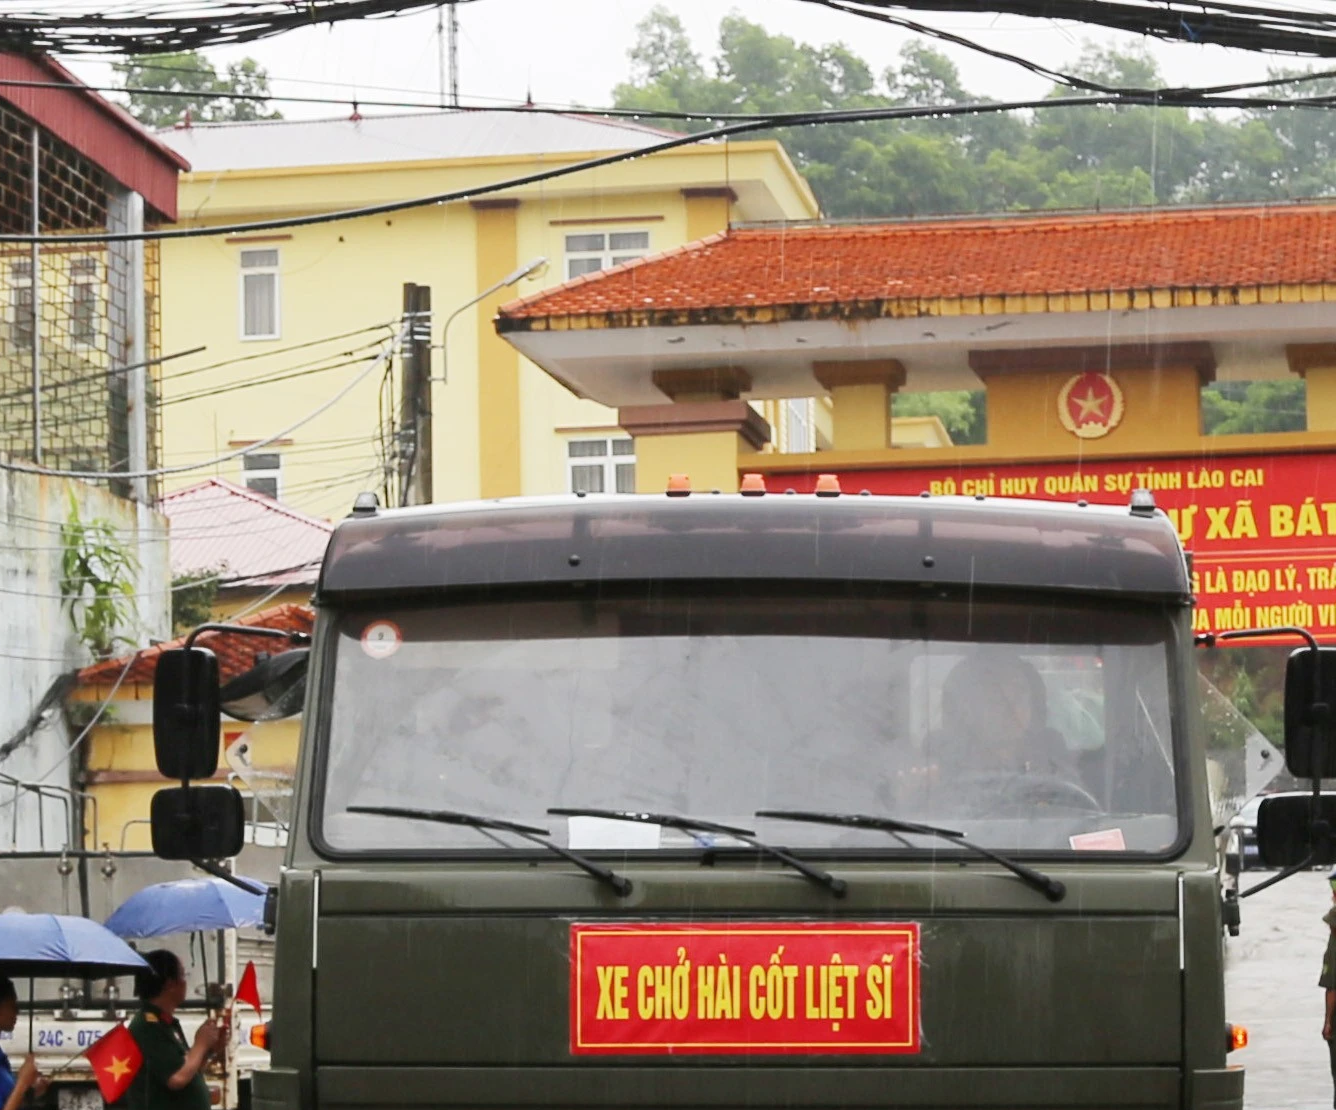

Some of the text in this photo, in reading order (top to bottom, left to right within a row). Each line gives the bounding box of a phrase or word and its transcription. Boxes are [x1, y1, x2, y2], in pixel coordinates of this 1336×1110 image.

[962, 473, 995, 497] CHỈ
[1000, 478, 1038, 495] HUY
[1045, 472, 1098, 493] QUÂN
[1104, 472, 1132, 494] SỰ
[1187, 467, 1225, 489] LÀO
[1230, 469, 1264, 487] CAI
[1167, 504, 1198, 549] Ự
[1205, 499, 1259, 540] XÃ
[1205, 565, 1228, 593] LÀ
[1232, 569, 1270, 597] ĐẠO
[1275, 562, 1303, 593] LÝ,
[1214, 600, 1251, 630] MỖI
[1256, 599, 1313, 629] NGƯỜI
[596, 946, 894, 1031] XE CHỞ HÀI CỐT LIỆT SĨ
